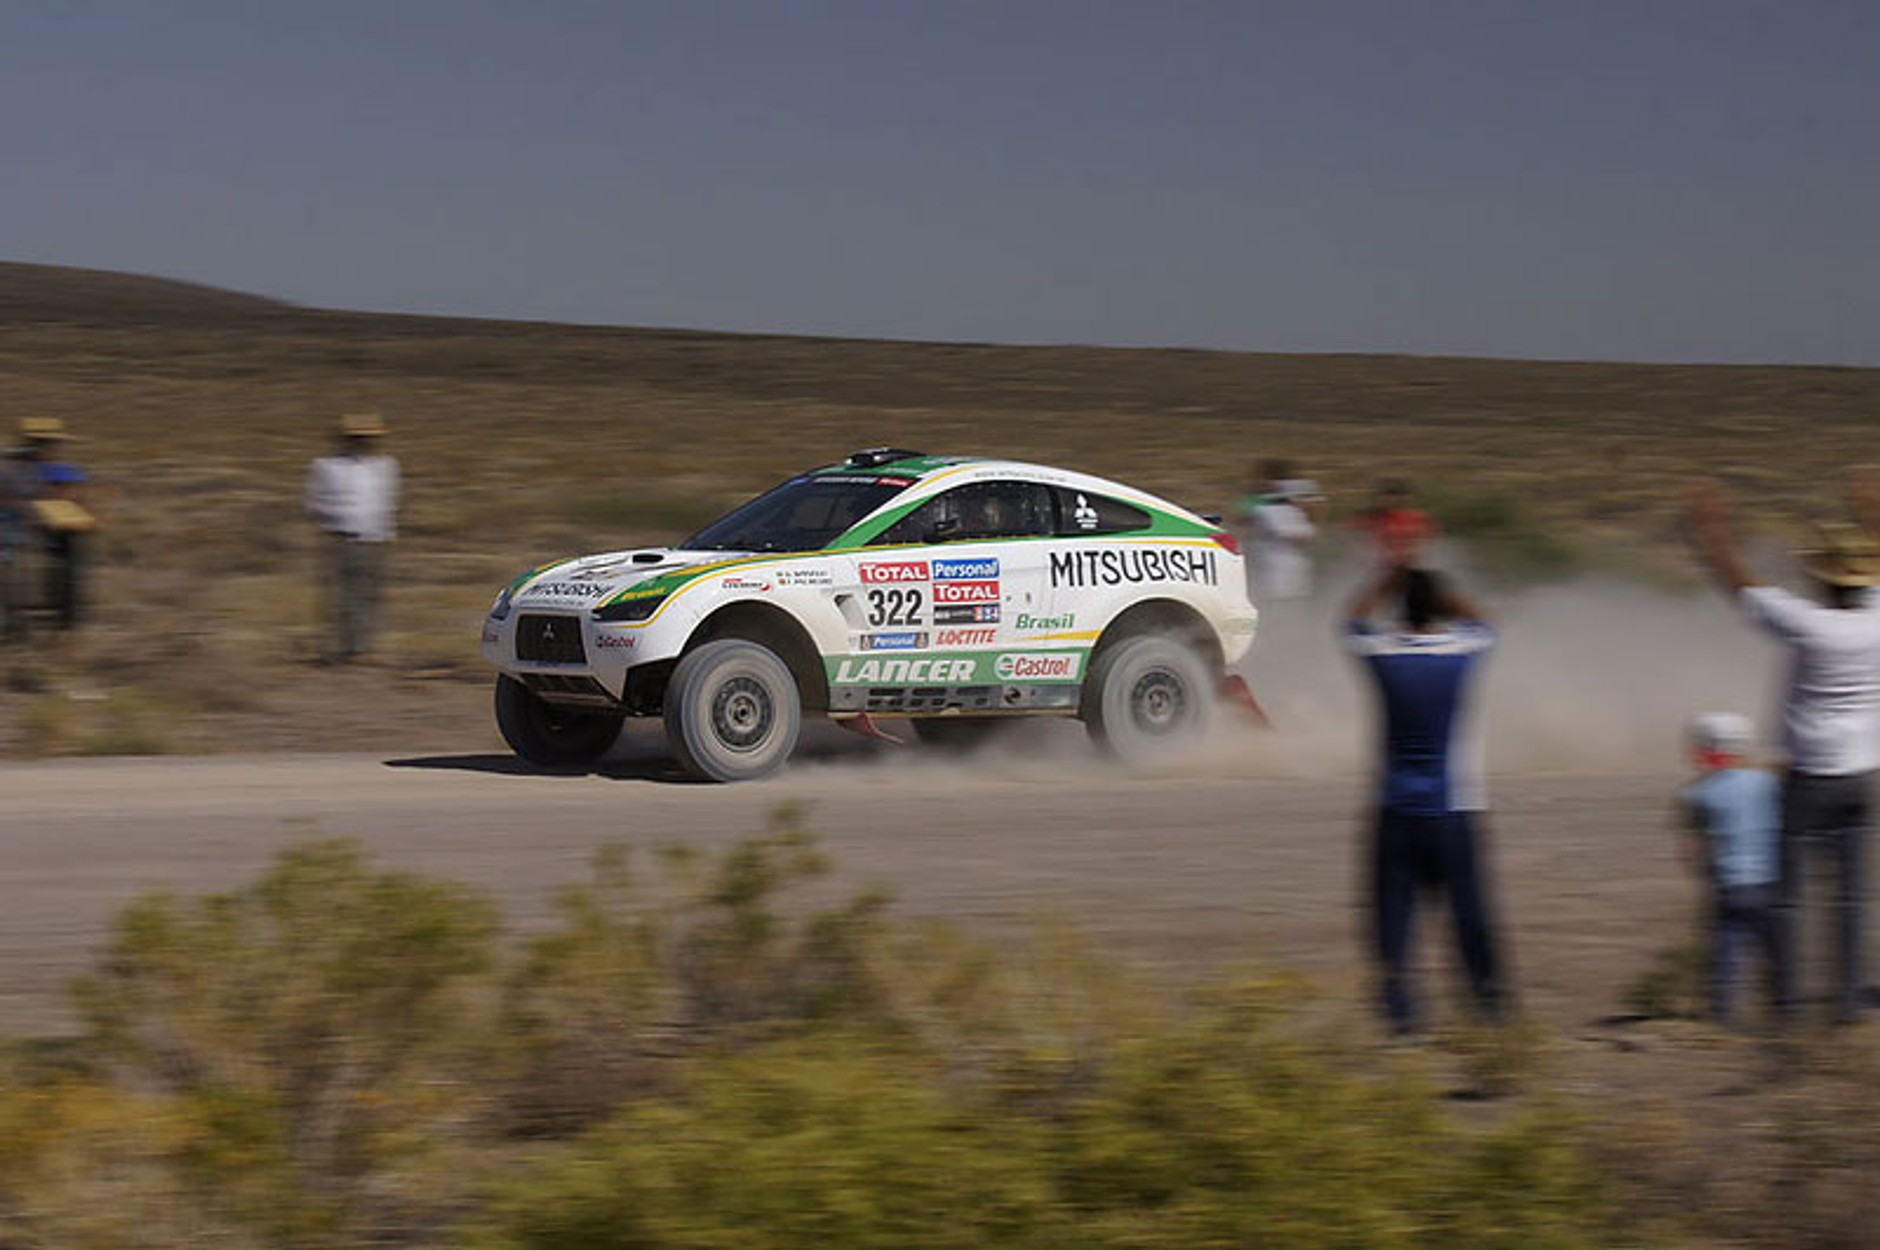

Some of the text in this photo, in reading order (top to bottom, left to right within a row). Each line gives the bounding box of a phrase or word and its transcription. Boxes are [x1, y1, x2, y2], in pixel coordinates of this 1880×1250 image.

[861, 564, 927, 581] TOTAL
[934, 560, 998, 577] Personal
[1050, 550, 1217, 588] MITSUBISHI
[935, 584, 998, 600] TOTAL
[868, 589, 923, 627] 322
[1015, 613, 1075, 630] Brasil
[936, 629, 997, 645] LOCTITE
[835, 659, 977, 683] LANCER
[1013, 657, 1071, 675] Castrol
